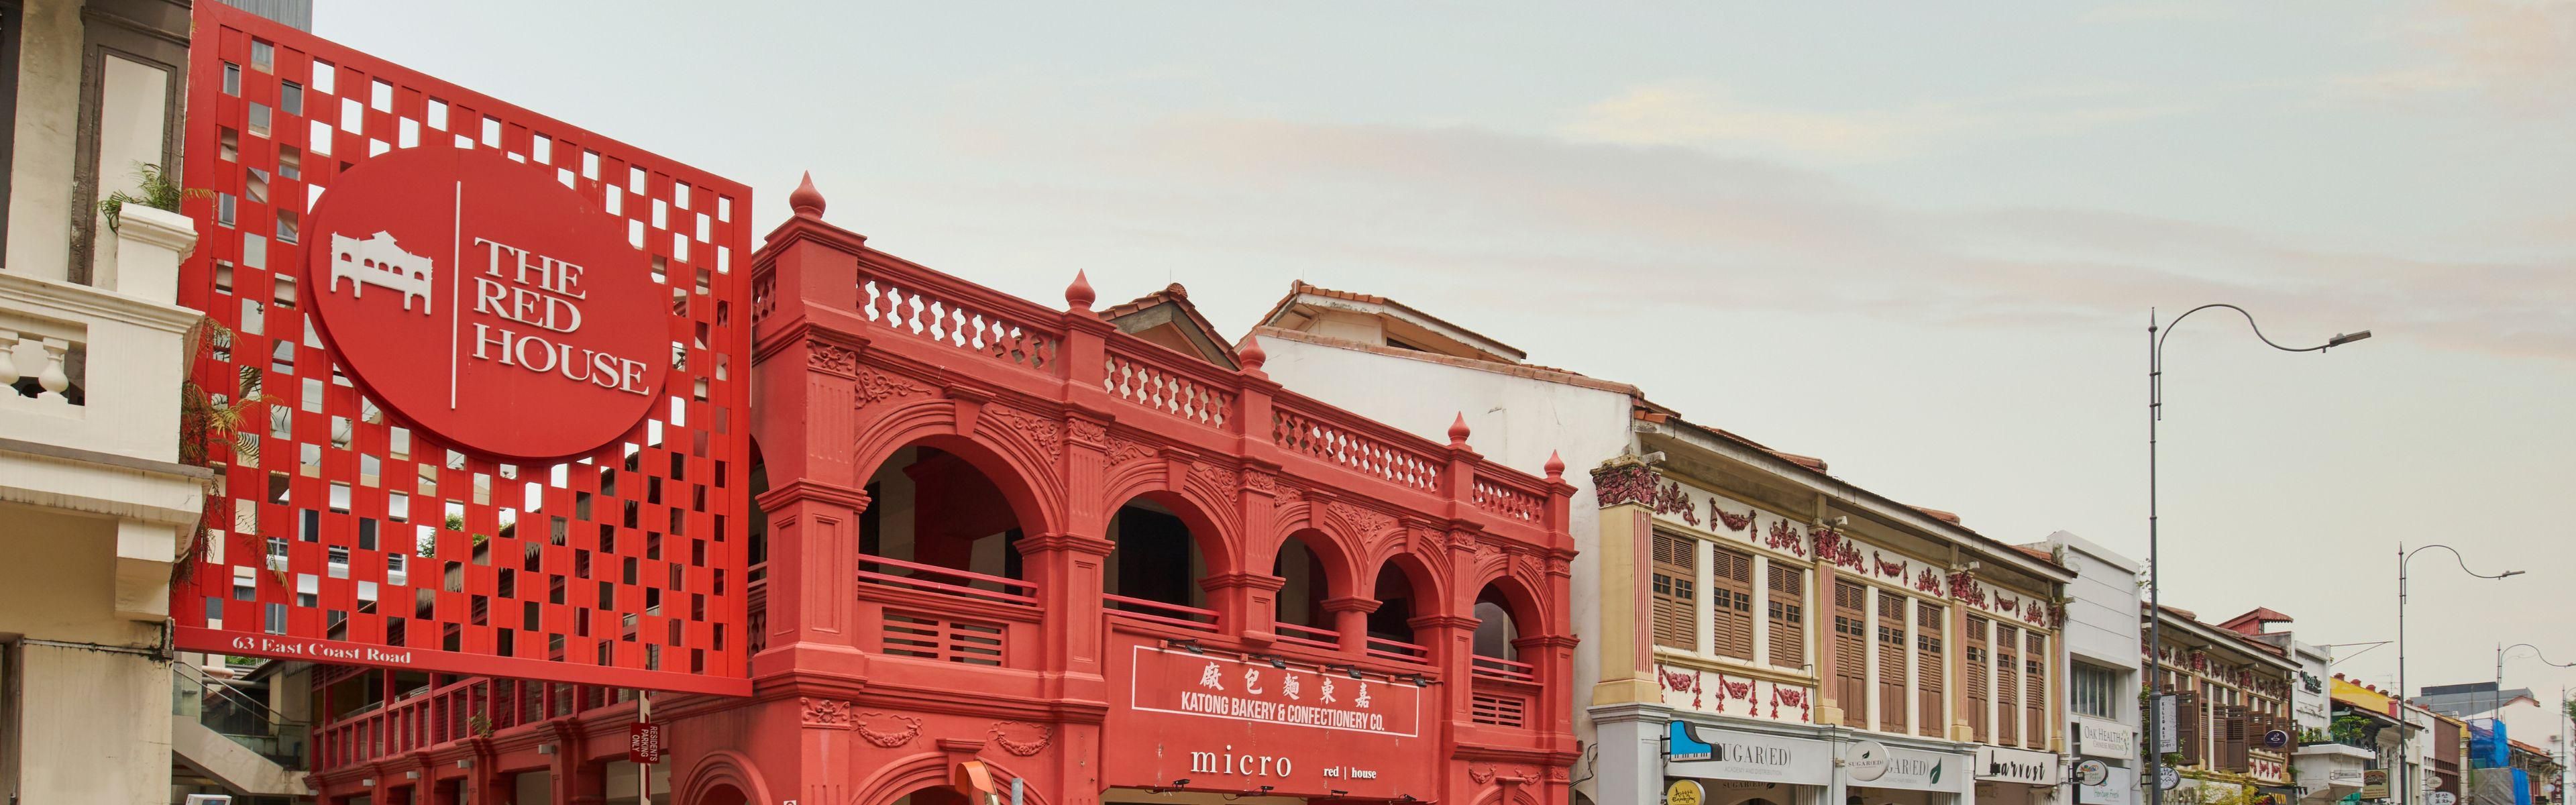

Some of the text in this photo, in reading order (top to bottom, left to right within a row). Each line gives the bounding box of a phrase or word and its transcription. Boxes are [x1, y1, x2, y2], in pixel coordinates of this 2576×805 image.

[474, 237, 586, 300] THE
[473, 276, 581, 333] RED
[472, 323, 649, 395] HOUSE
[233, 637, 411, 664] 63 East Coast Road
[1181, 691, 1385, 731] KATONG BAKERY & CONFECTIONERY CO.
[632, 735, 640, 752] ONLY
[641, 729, 649, 757] PARKING
[649, 726, 658, 761] RESIDENTS
[1716, 742, 1791, 767] UGAR(ED)
[1191, 745, 1291, 777] micro
[1324, 766, 1377, 780] red house
